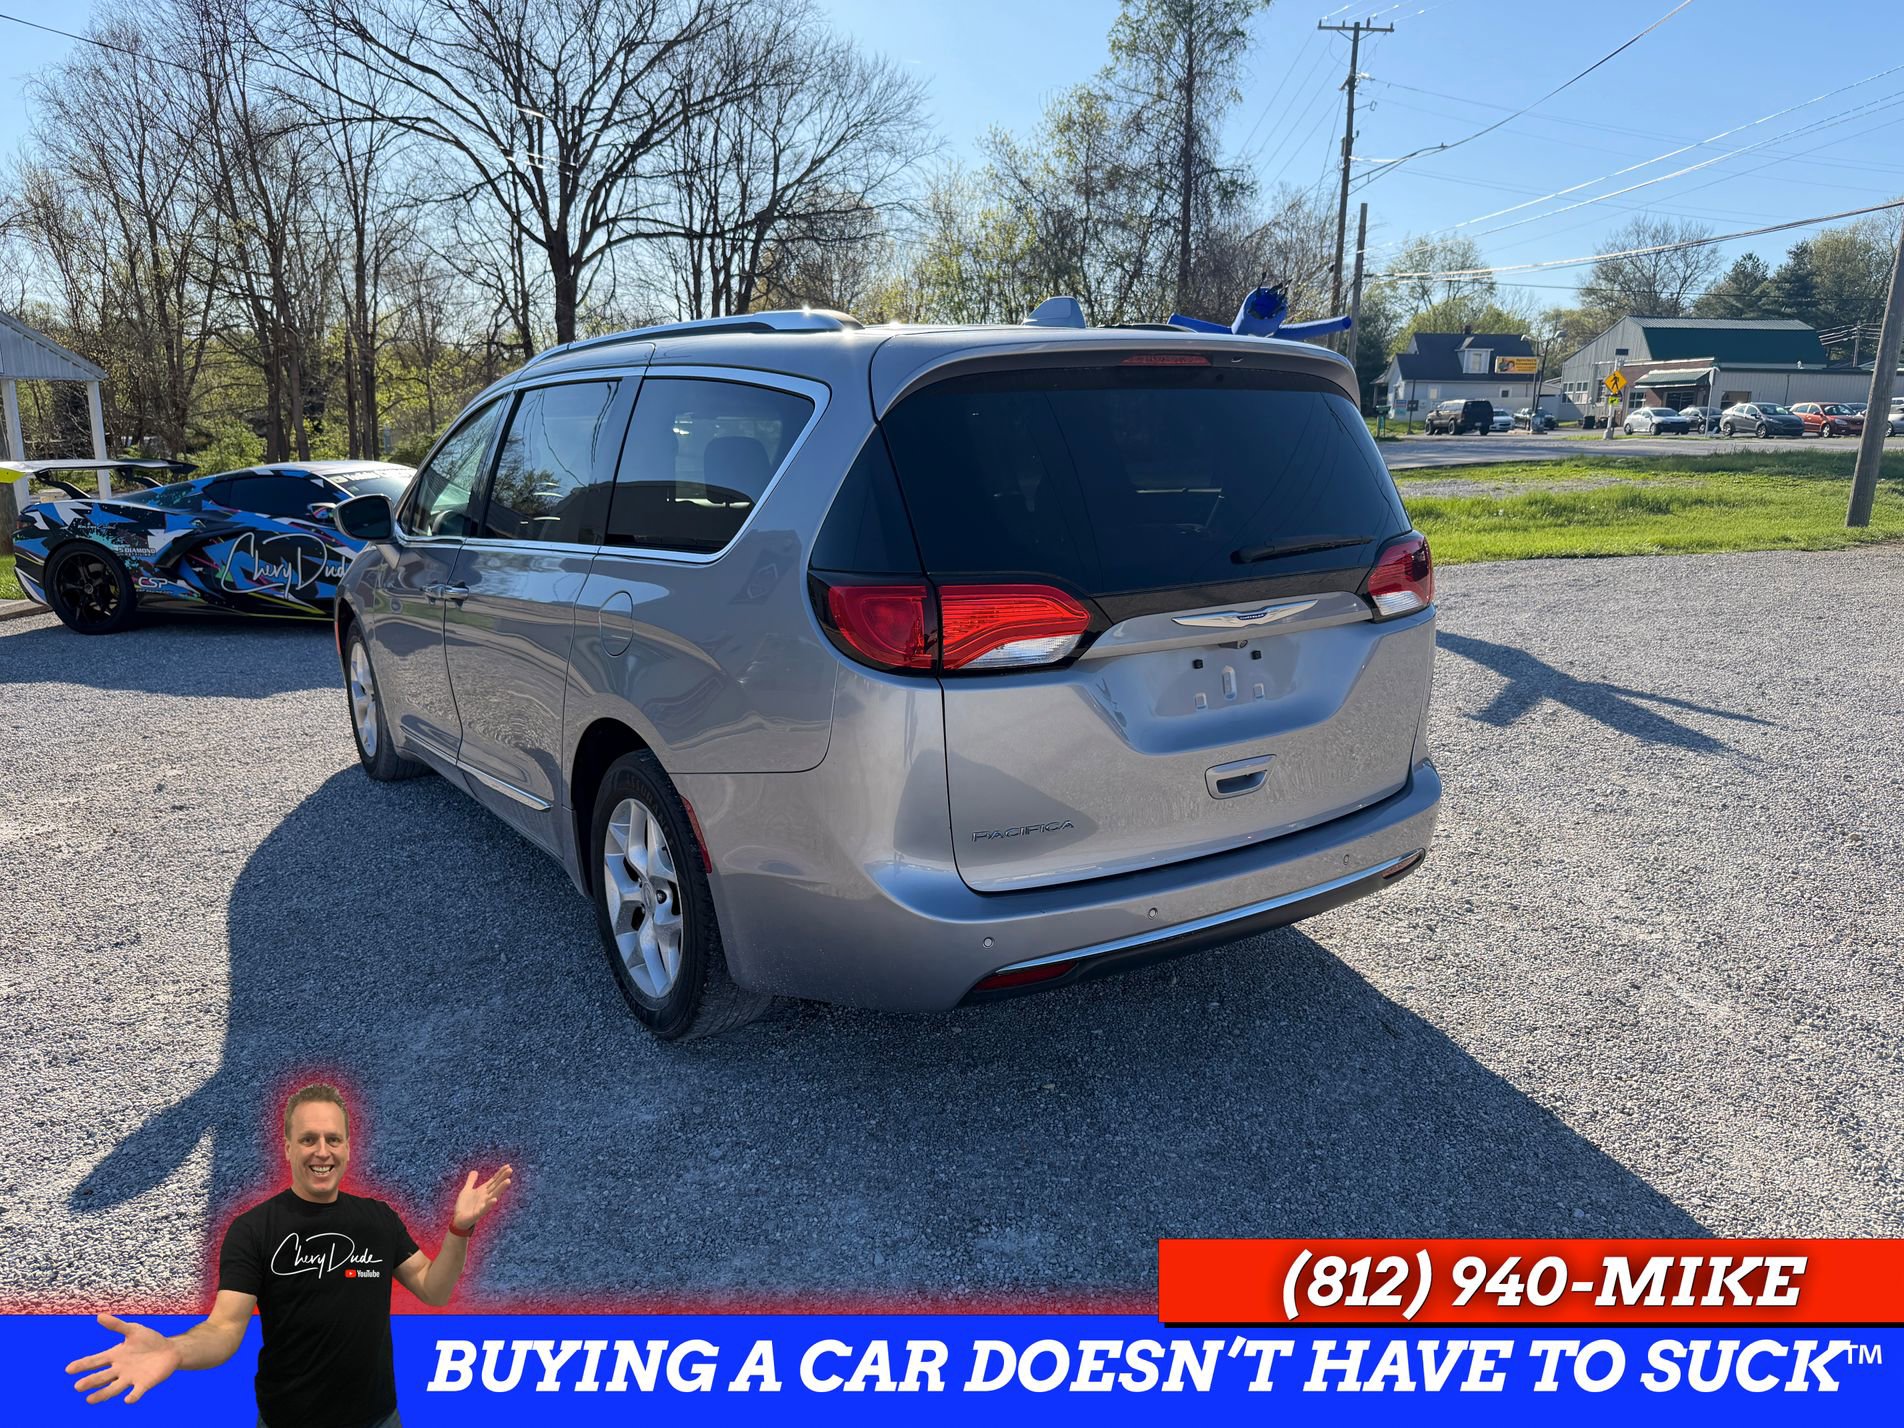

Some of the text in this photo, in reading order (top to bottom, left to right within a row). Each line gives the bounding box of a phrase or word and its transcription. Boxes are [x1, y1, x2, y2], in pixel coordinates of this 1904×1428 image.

[138, 577, 168, 588] CSP
[971, 820, 1075, 842] PACIFICA
[357, 1270, 380, 1278] YouTube
